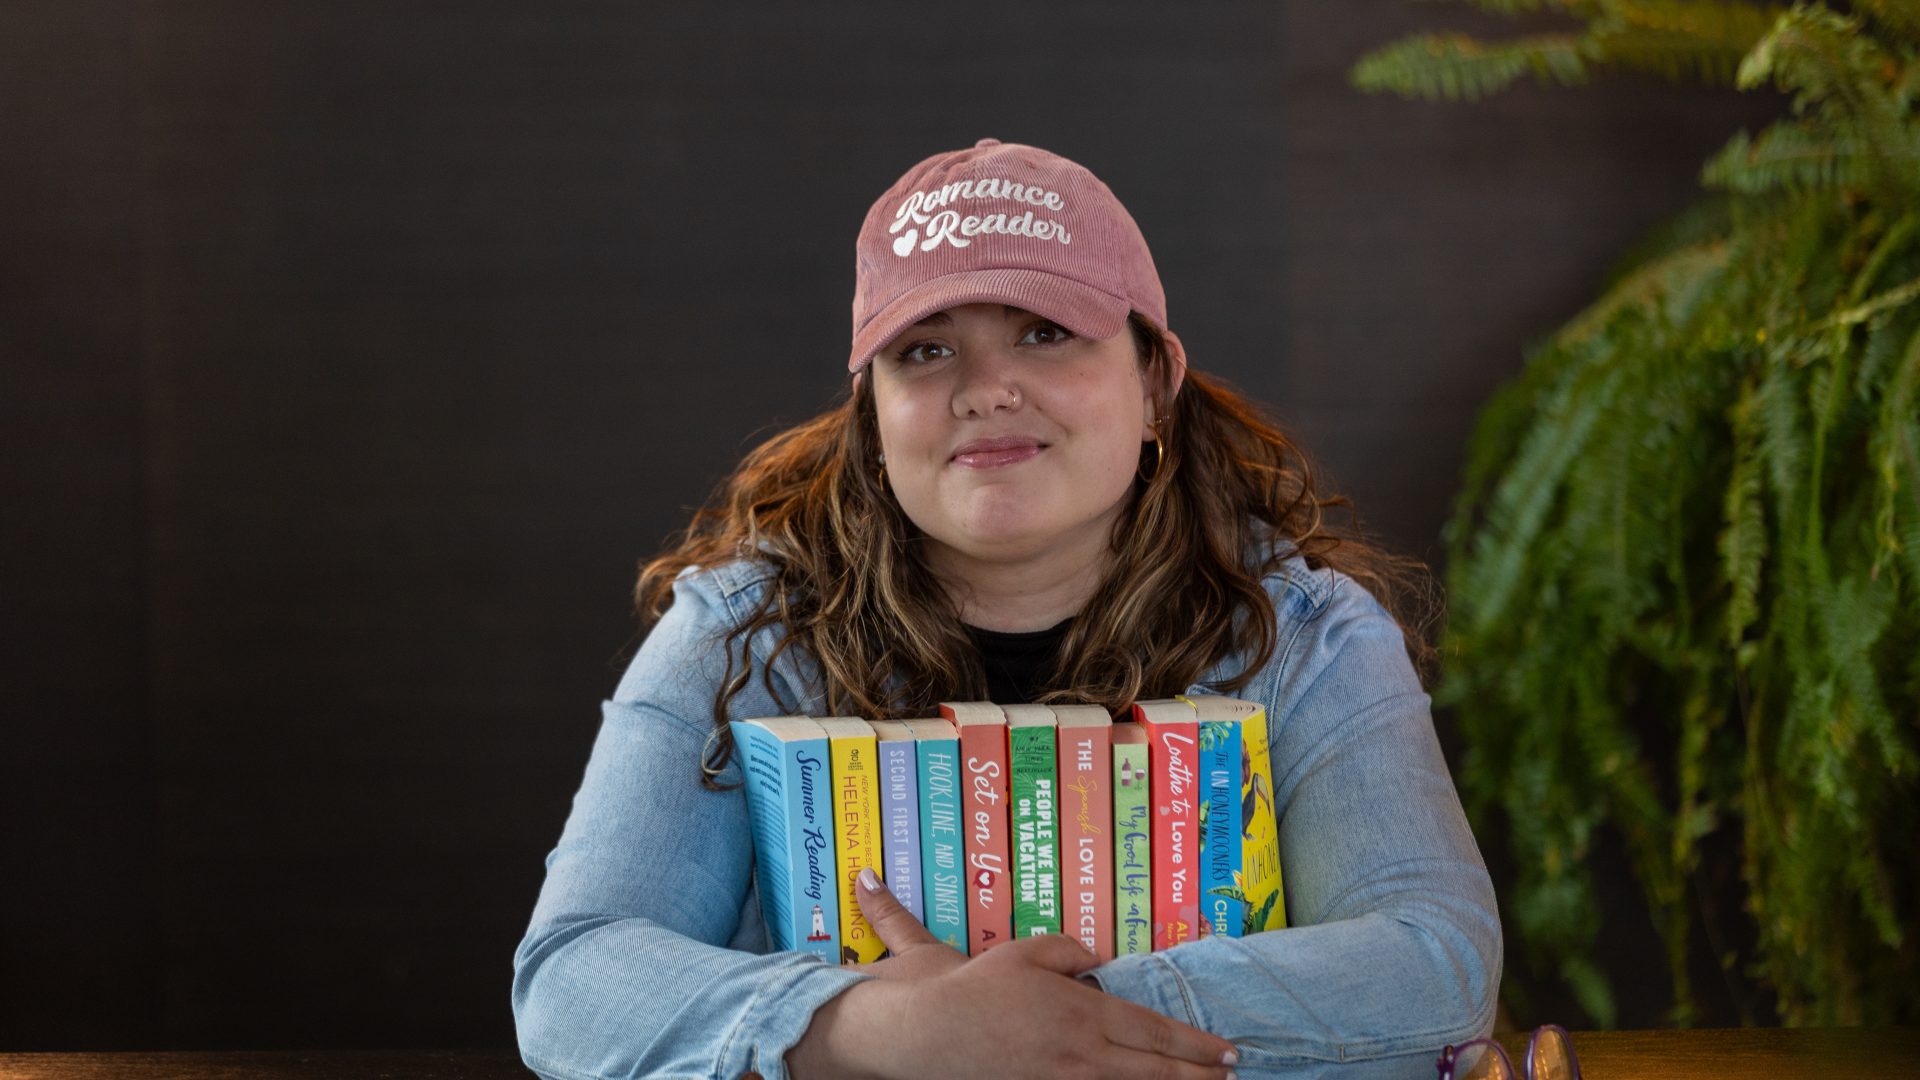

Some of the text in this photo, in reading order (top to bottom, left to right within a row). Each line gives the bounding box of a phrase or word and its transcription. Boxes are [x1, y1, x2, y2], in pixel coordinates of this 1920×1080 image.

[889, 178, 1064, 234] Romance
[920, 210, 1071, 252] Reader
[889, 750, 906, 801] SECOND
[1077, 739, 1092, 772] THE
[861, 775, 869, 795] NEW
[968, 757, 1000, 806] Set
[796, 750, 827, 900] Summer Reading
[843, 775, 860, 851] HELENA
[863, 797, 871, 819] YORK
[892, 807, 908, 844] FIRST
[930, 801, 956, 838] LINE,
[975, 811, 991, 847] on
[1035, 779, 1051, 840] PEOPLE
[1119, 805, 1147, 830] My
[1162, 731, 1194, 904] Loathe to Love You
[1210, 771, 1230, 882] UNHONEYMOONERS
[864, 821, 872, 845] TIMES
[1018, 798, 1037, 902] ON VACATION
[1123, 832, 1148, 869] Good
[935, 842, 954, 869] AND
[1037, 843, 1053, 870] WE
[1079, 838, 1094, 885] LOVE
[934, 872, 960, 926] SINKER
[1038, 873, 1055, 918] MEET
[1119, 873, 1149, 897] Life
[1080, 892, 1096, 955] DECEP
[1127, 902, 1141, 917] in
